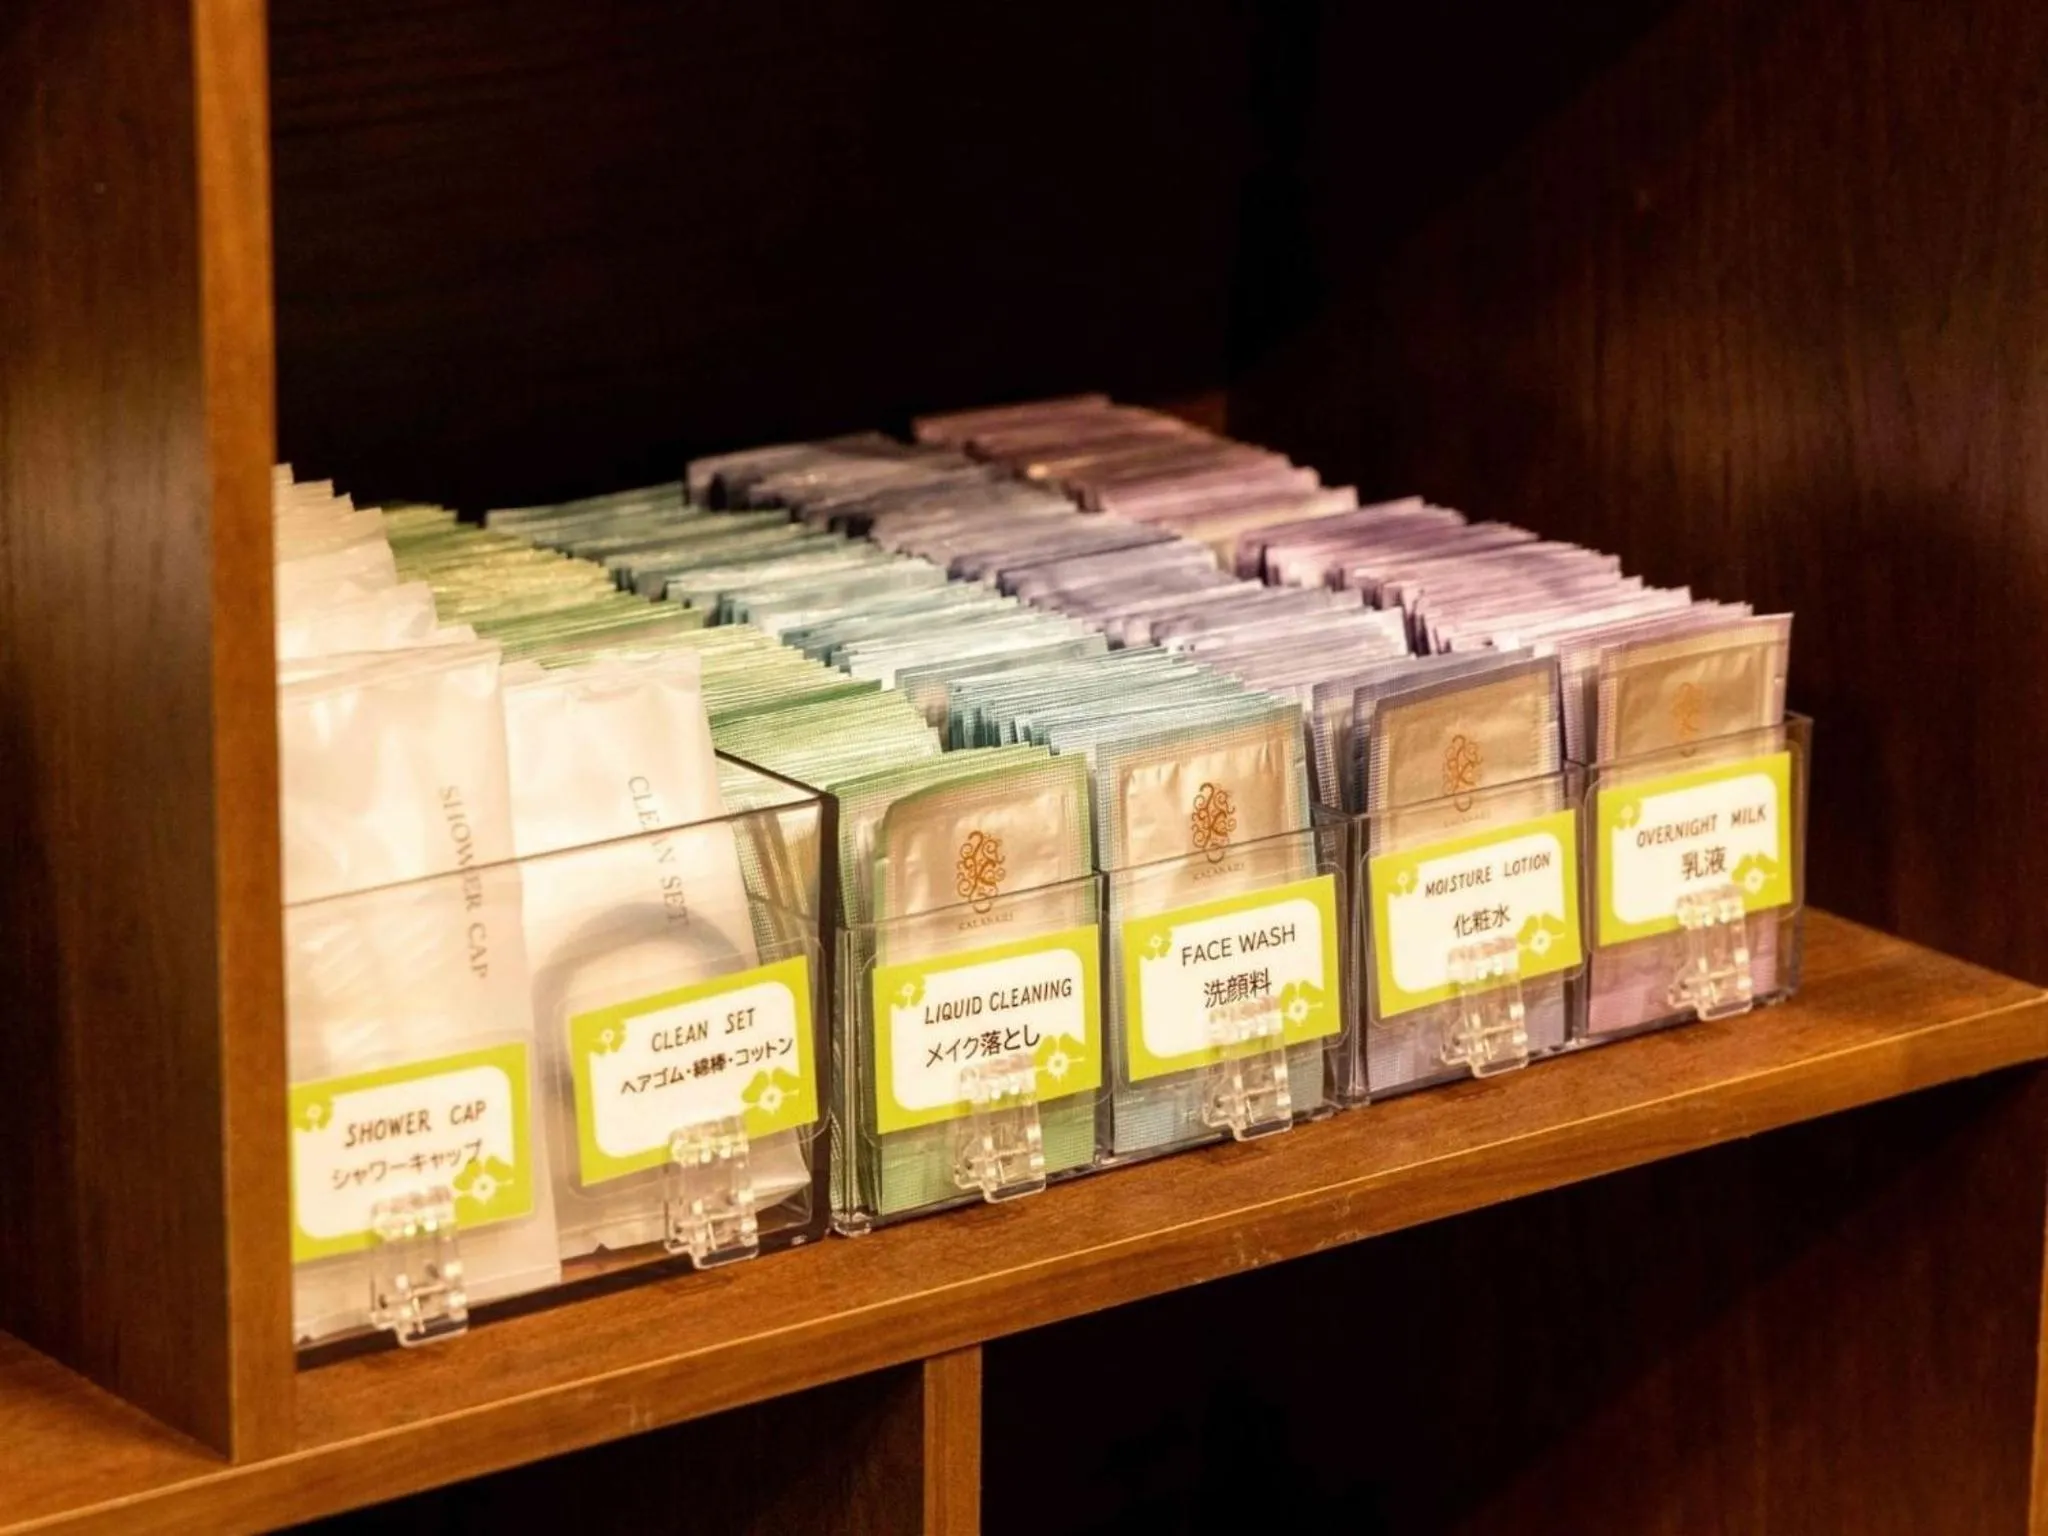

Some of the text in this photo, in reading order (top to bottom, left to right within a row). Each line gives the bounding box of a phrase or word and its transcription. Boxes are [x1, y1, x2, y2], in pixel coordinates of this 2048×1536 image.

[1636, 803, 1767, 848] OVERNIGHT MILK
[439, 785, 490, 979] SHOWER CAP
[1425, 851, 1551, 898] MOISTURE LOTION
[1681, 845, 1728, 881] 乳液
[661, 875, 690, 926] SET
[1453, 901, 1511, 939] 化粧水
[1181, 922, 1296, 968] FACE WASH
[924, 977, 1072, 1025] LIQUID CLEANING
[1203, 967, 1272, 1008] 洗顔料
[651, 1007, 756, 1053] CLEAN SET
[926, 1024, 1040, 1068] メイク落とし
[344, 1099, 486, 1149] SHOWER CAP
